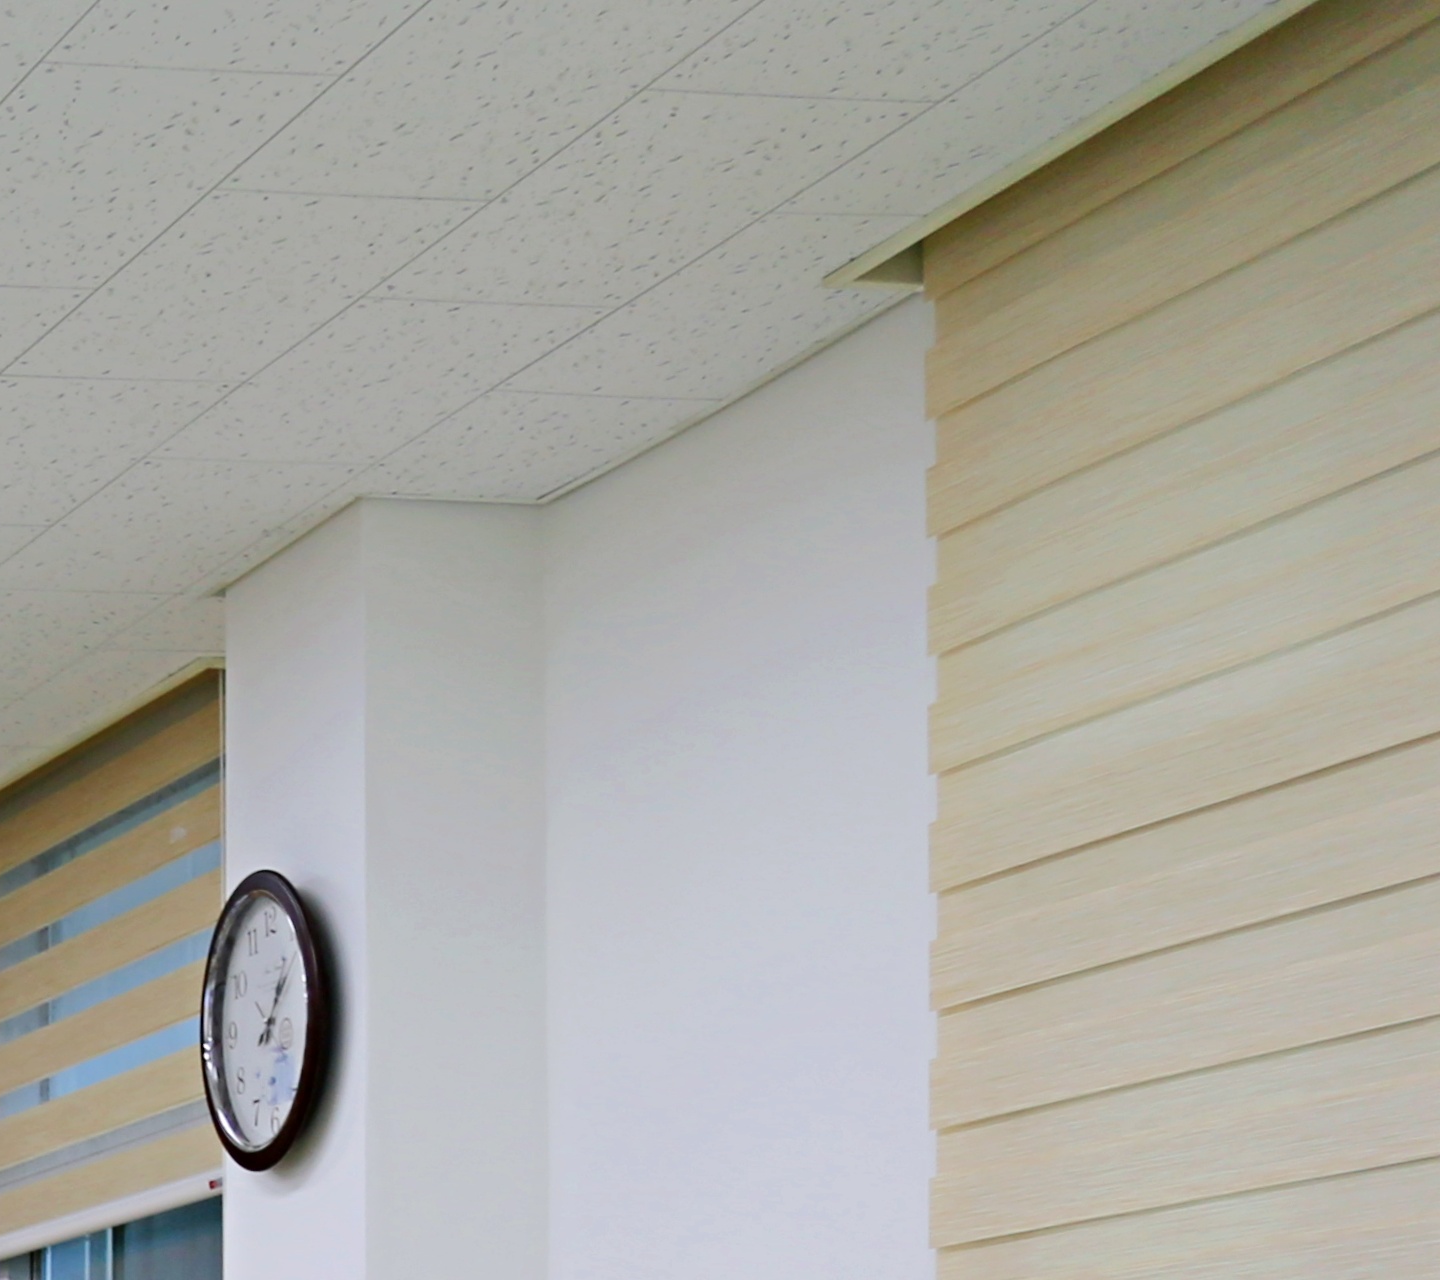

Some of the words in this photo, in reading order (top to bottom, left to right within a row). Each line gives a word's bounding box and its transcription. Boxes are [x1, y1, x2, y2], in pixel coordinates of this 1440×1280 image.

[247, 928, 259, 957] 11
[236, 1066, 246, 1095] 8
[252, 1098, 261, 1127] 7
